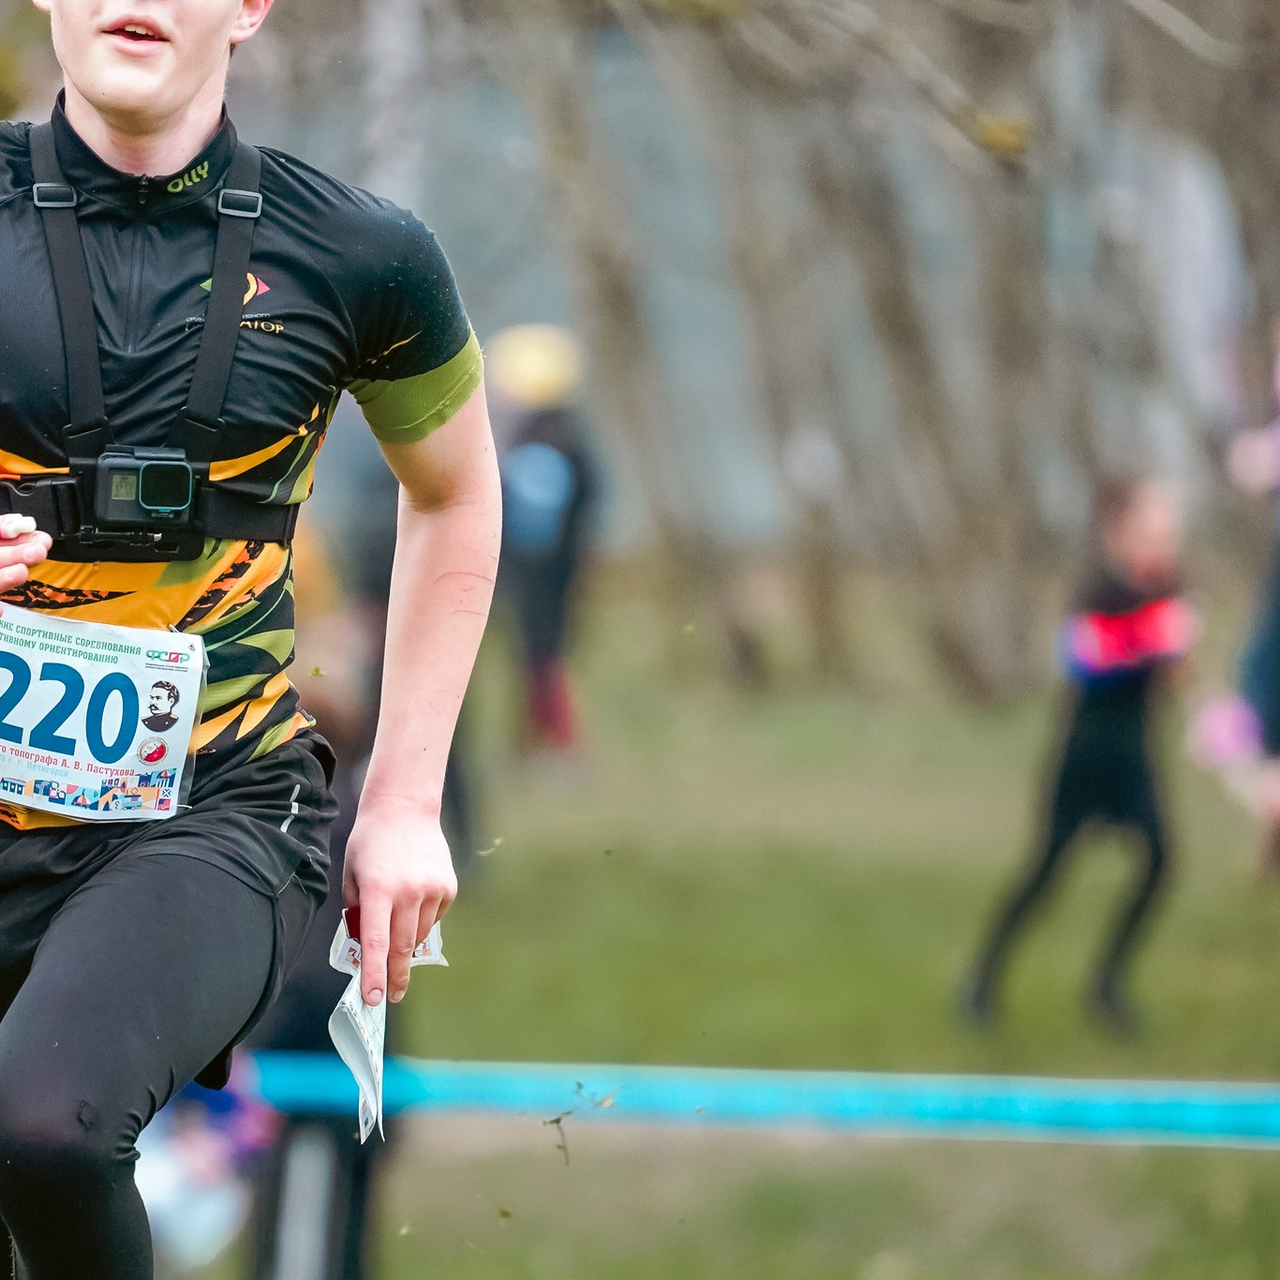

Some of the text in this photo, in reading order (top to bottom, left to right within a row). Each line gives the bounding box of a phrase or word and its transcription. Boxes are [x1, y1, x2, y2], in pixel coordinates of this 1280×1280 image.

[167, 161, 209, 193] OLLY
[15, 624, 73, 643] СПОРТИВНЫЕ
[75, 637, 142, 656] СОРЕВНОВАНИЯ
[38, 642, 119, 664] ОРИЕНТИРОВАНИЮ
[10, 748, 58, 766] топографа
[61, 759, 70, 768] А.
[74, 761, 83, 771] В.
[86, 763, 135, 777] Пастухова
